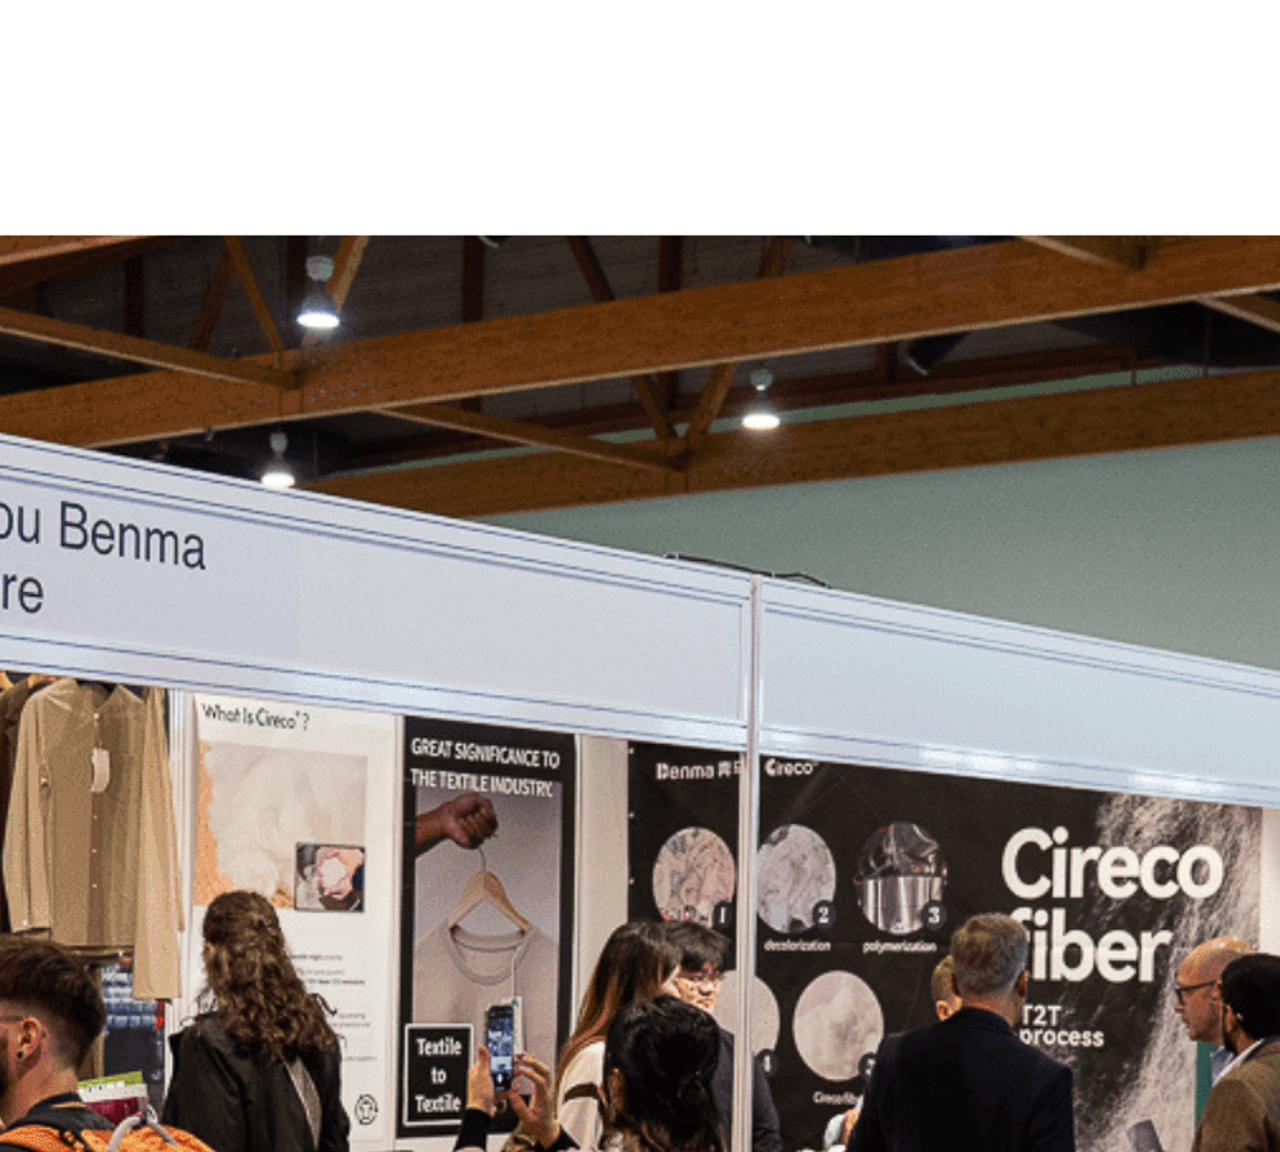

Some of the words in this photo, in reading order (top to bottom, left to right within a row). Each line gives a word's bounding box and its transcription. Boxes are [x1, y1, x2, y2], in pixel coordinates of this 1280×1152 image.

[59, 500, 207, 570] Benma
[202, 702, 240, 724] What
[411, 738, 452, 760] GREAT
[454, 742, 539, 768] SIGNIFICANCE
[542, 750, 560, 769] TO
[410, 768, 438, 788] THE
[439, 770, 489, 793] TEXTILE
[656, 763, 715, 780] Benma
[1002, 826, 1224, 900] Cireco
[818, 906, 829, 923] 2
[927, 906, 940, 923] 3
[863, 941, 937, 953] polymerization
[416, 1038, 462, 1056] Textile
[431, 1066, 447, 1083] to
[415, 1095, 461, 1113] Textile
